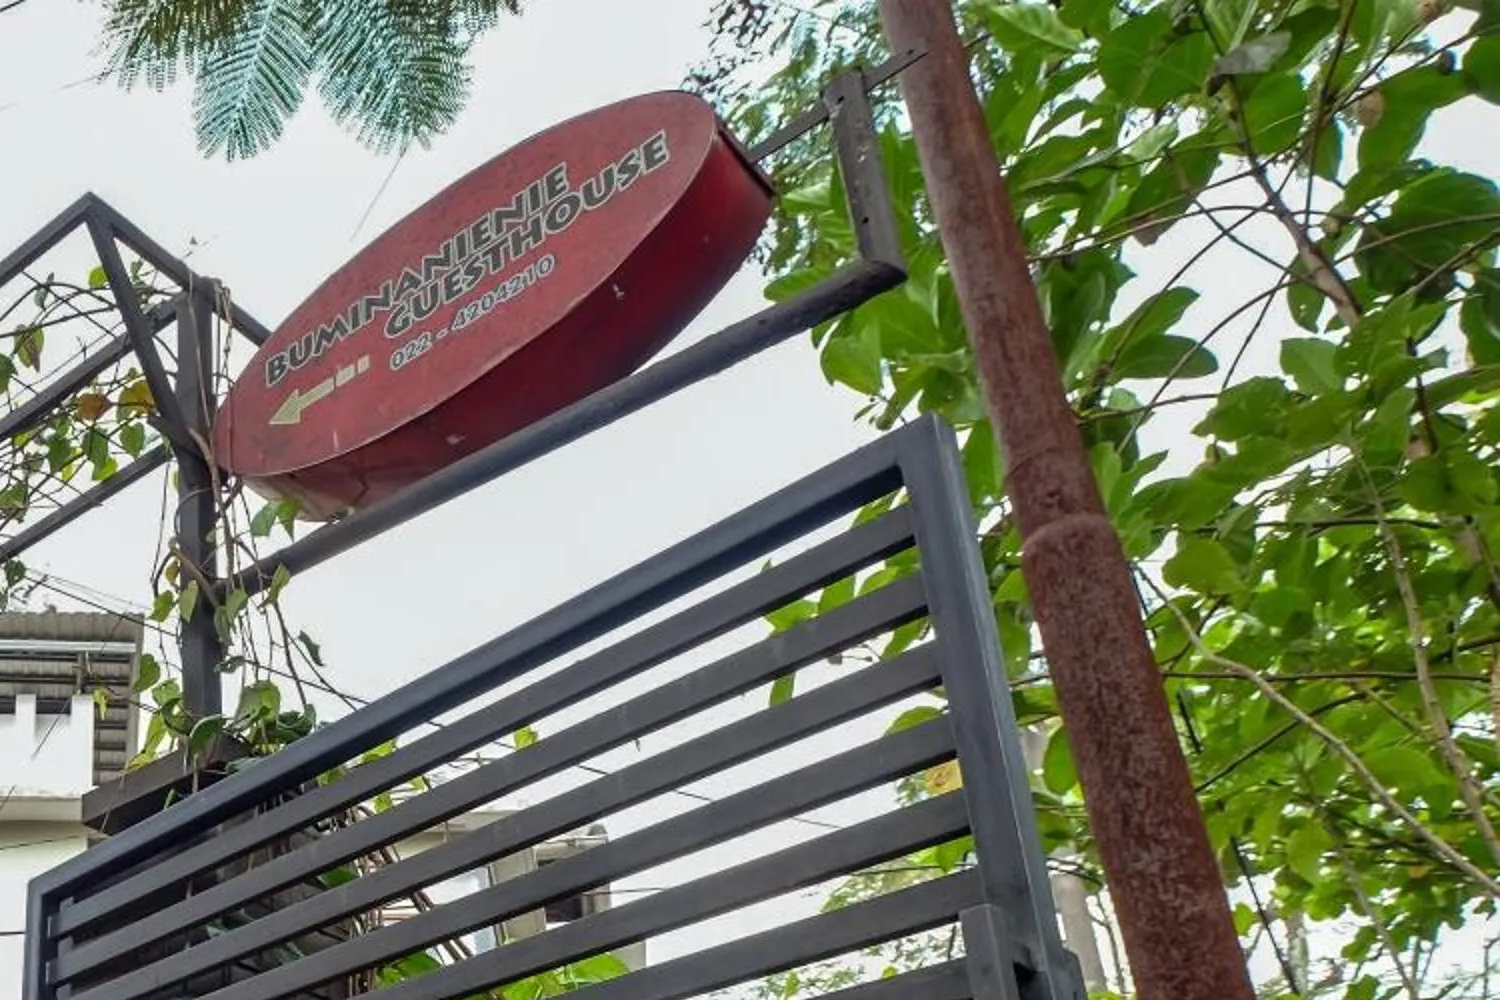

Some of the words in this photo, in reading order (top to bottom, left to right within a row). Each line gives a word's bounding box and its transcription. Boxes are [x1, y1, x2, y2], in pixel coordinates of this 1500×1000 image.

[265, 162, 570, 387] BUMINANIENIE
[384, 128, 671, 339] GUESTHOUSE
[389, 331, 433, 371] 022
[450, 254, 556, 332] 4204210
